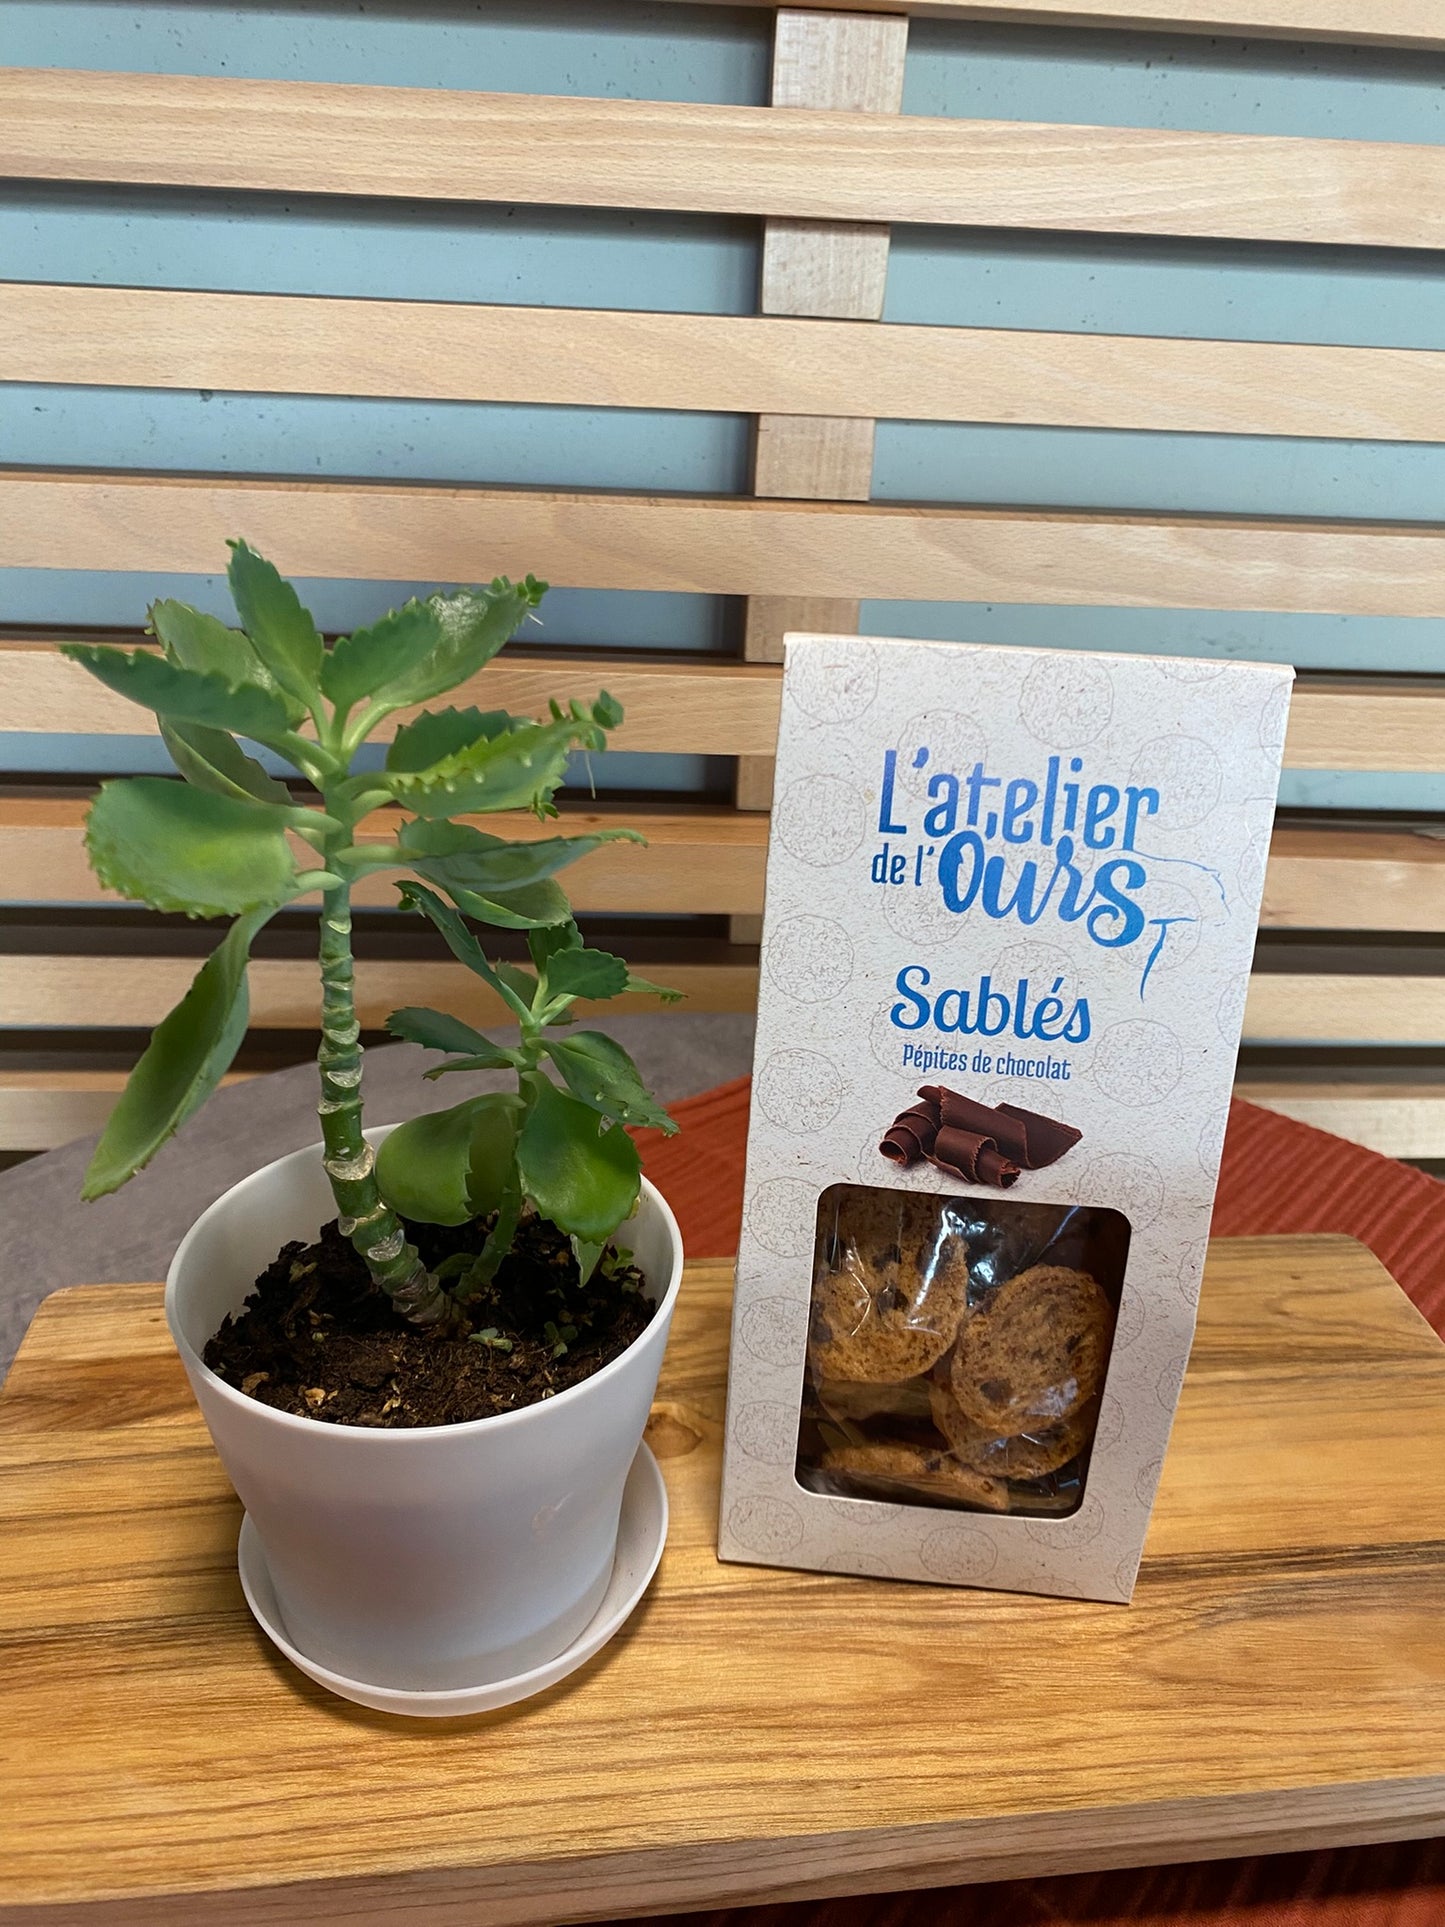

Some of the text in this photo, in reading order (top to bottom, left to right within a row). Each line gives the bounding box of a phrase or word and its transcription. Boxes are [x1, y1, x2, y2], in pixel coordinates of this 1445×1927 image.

[878, 747, 1160, 852] L'atelier
[871, 842, 907, 885] de
[890, 965, 1091, 1044] Sablés
[902, 1044, 1071, 1080] Pépites de chocolat
